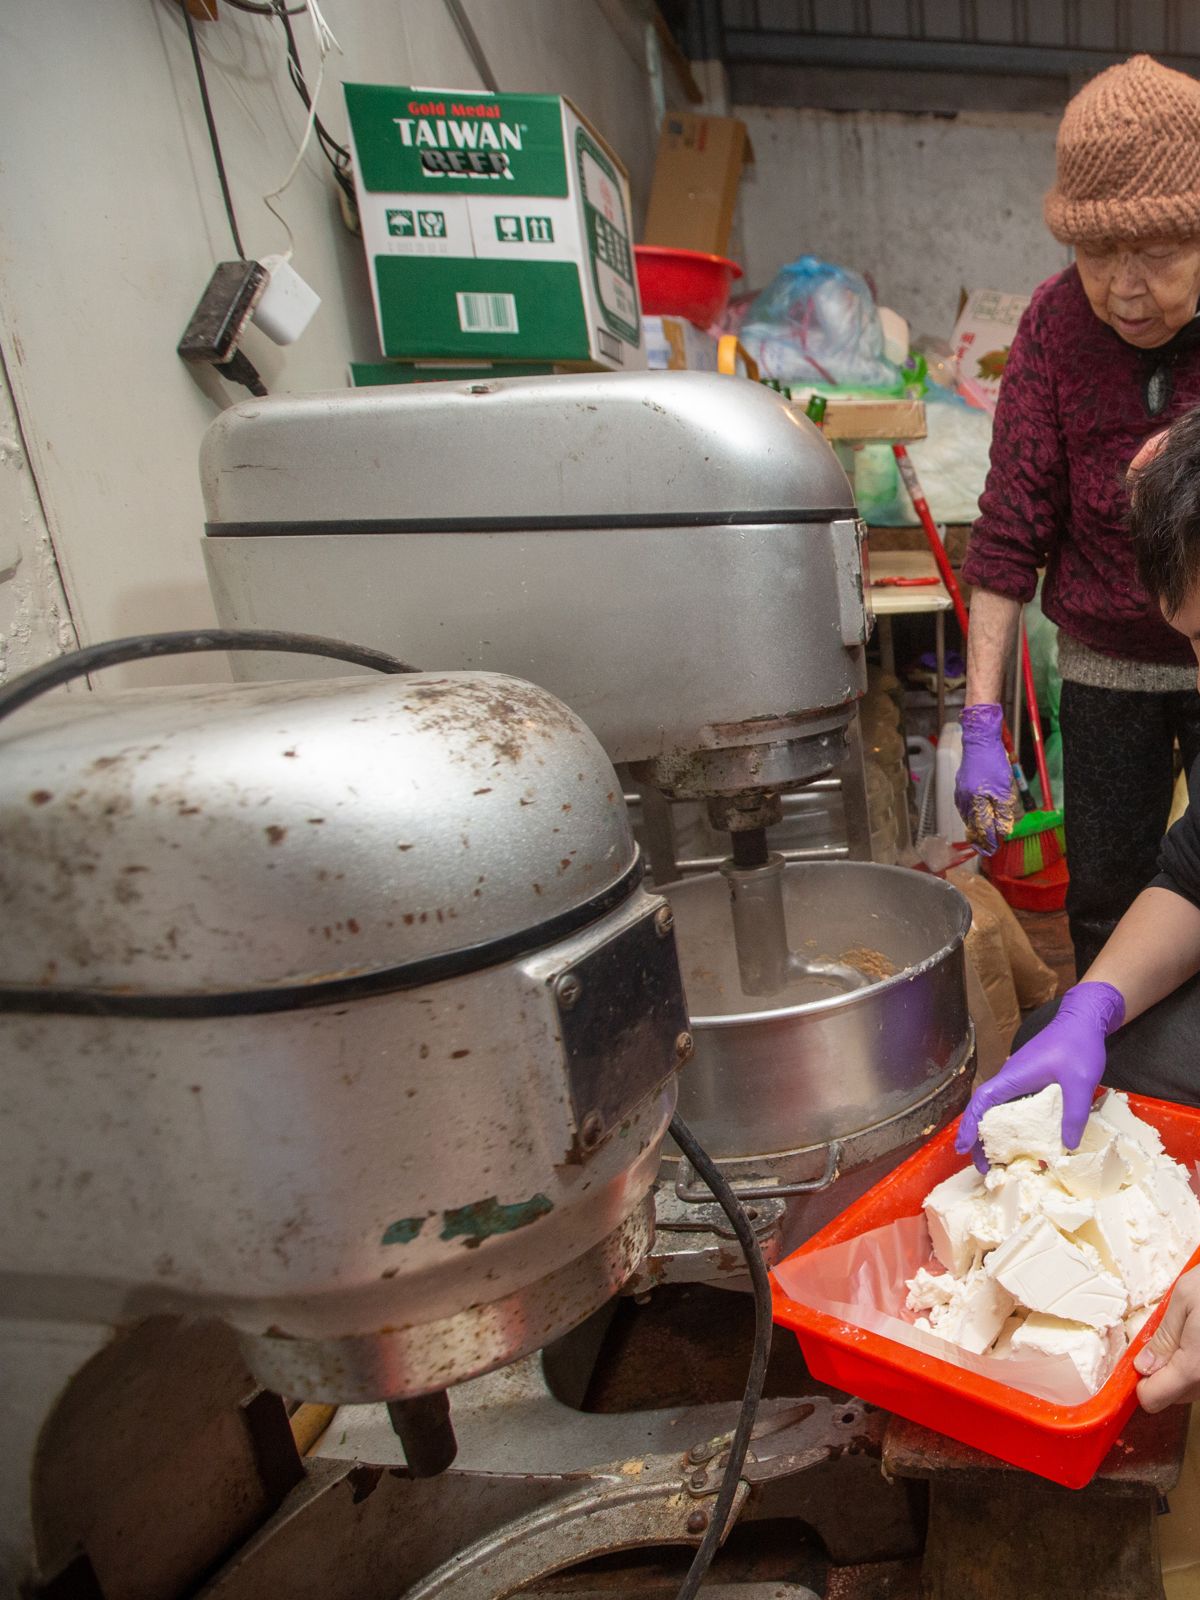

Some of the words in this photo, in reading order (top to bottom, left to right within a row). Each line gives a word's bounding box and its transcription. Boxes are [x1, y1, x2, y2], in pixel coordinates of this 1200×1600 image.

[408, 101, 446, 117] Gold
[452, 103, 501, 118] Medal
[392, 118, 523, 151] TAIWAN
